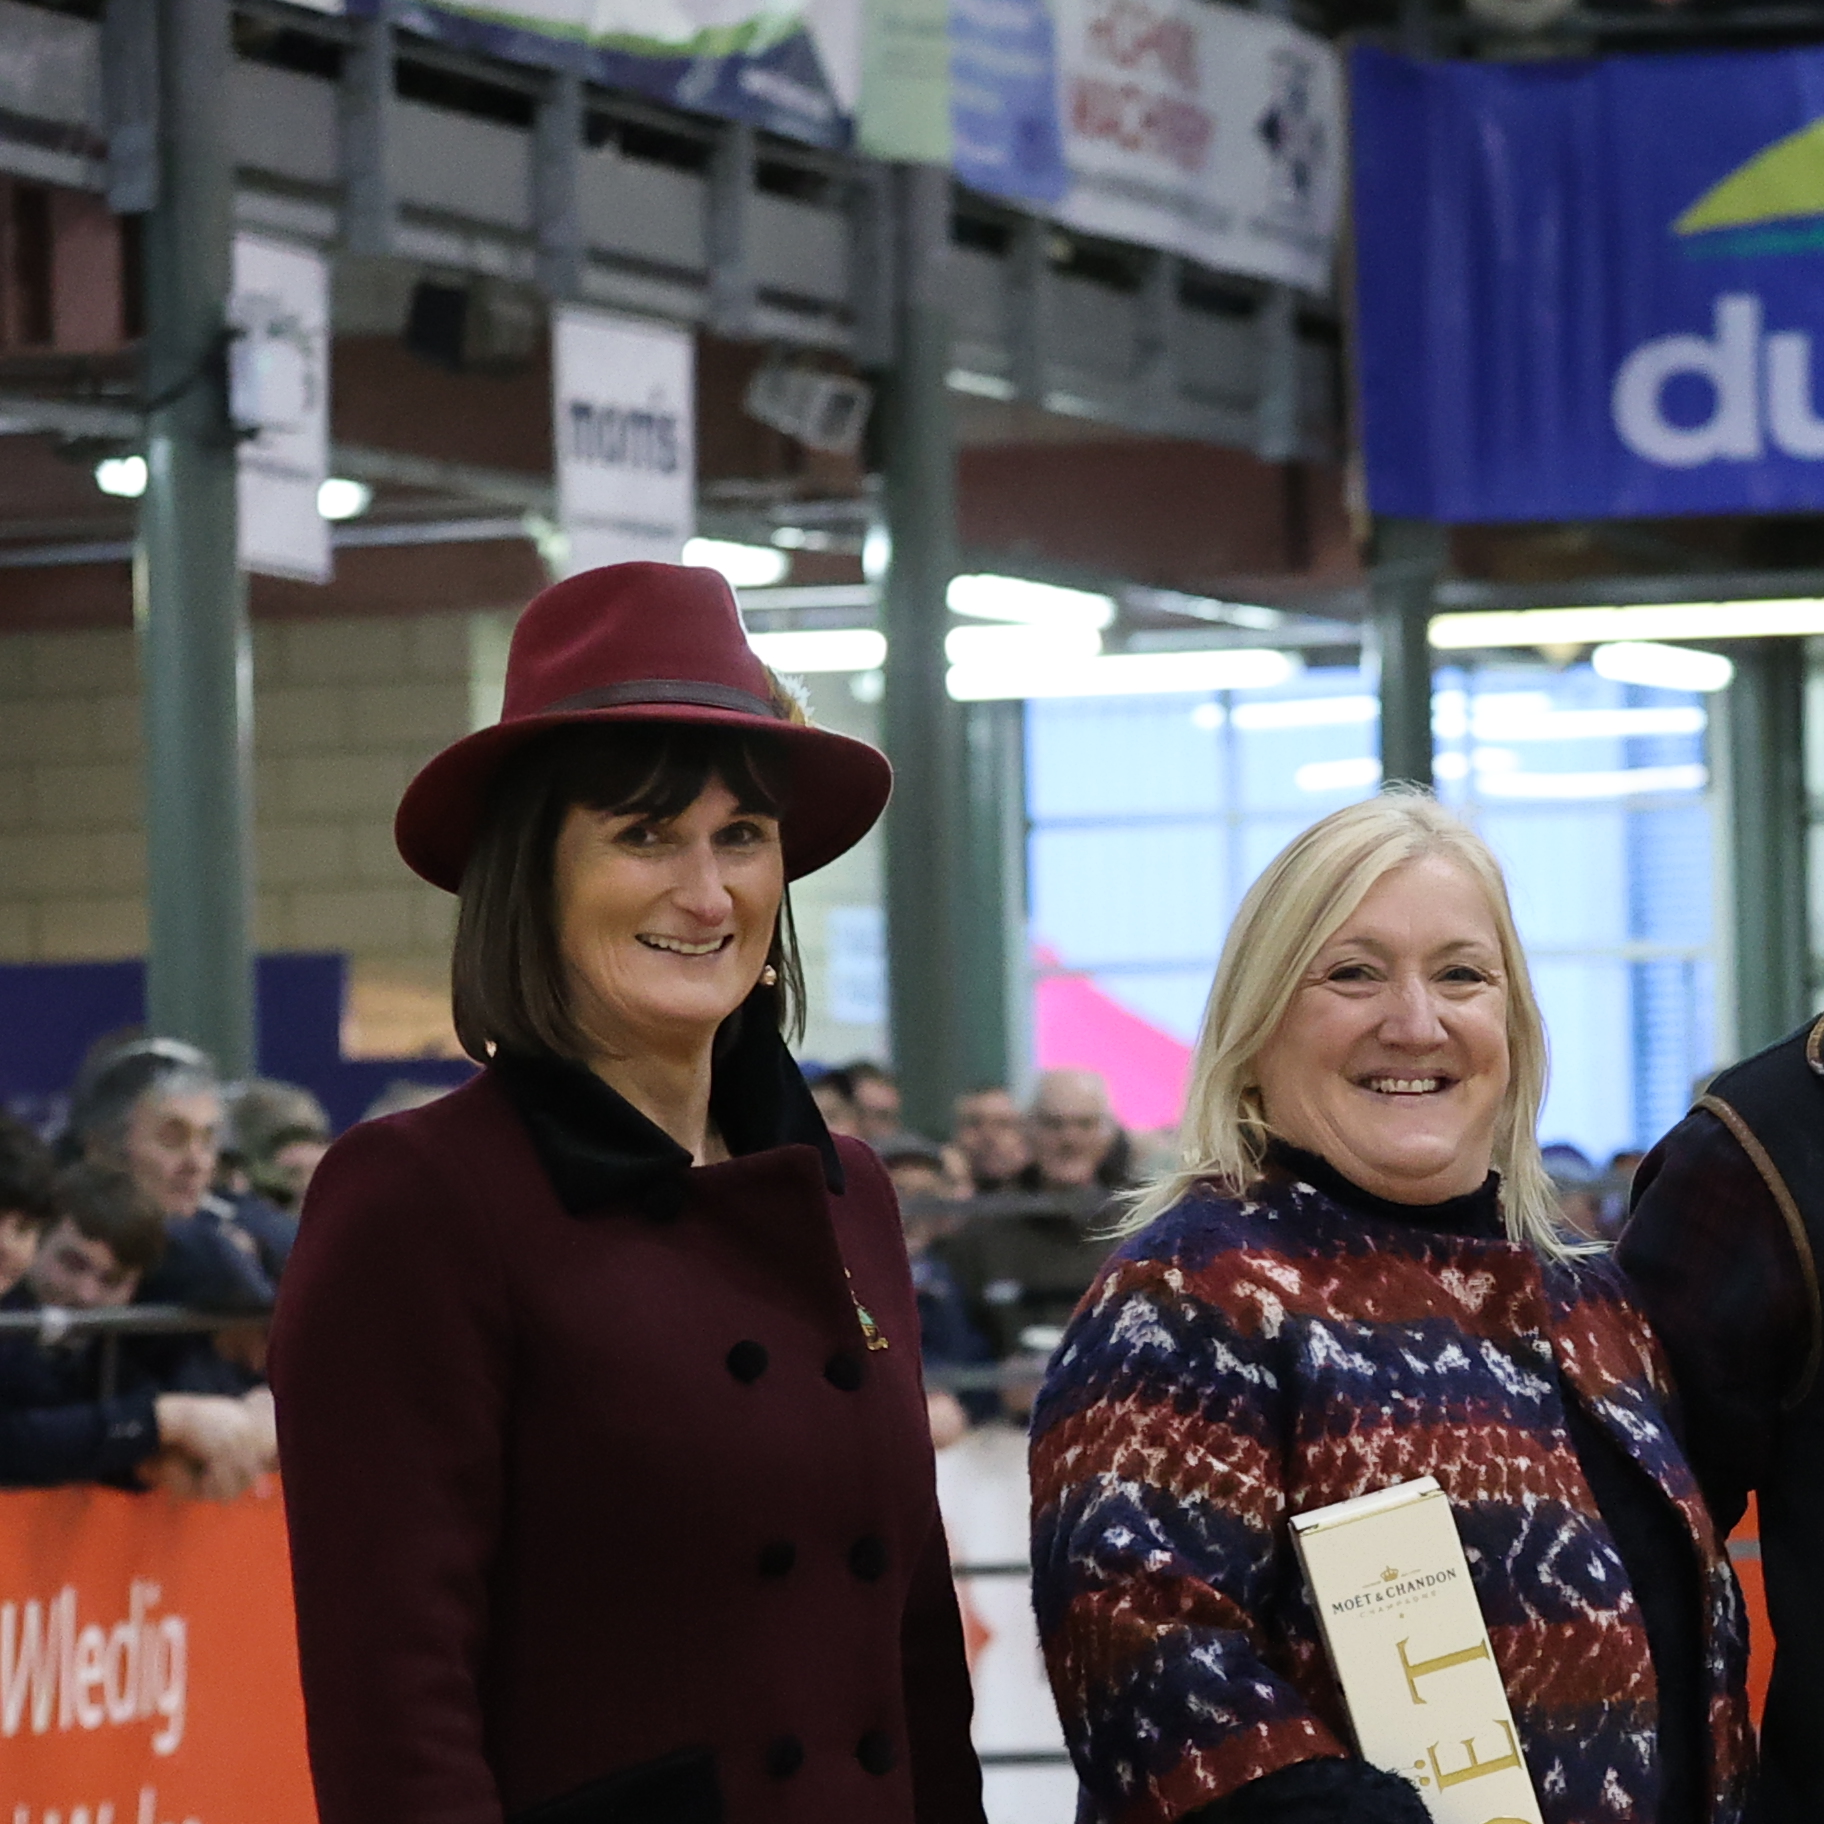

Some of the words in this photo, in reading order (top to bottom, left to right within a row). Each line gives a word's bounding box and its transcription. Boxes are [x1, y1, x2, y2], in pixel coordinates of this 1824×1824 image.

[1332, 1592, 1372, 1616] MOËT
[1375, 1592, 1385, 1603] &
[1385, 1568, 1458, 1599] CHANDON
[0, 1576, 188, 1756] Wledig
